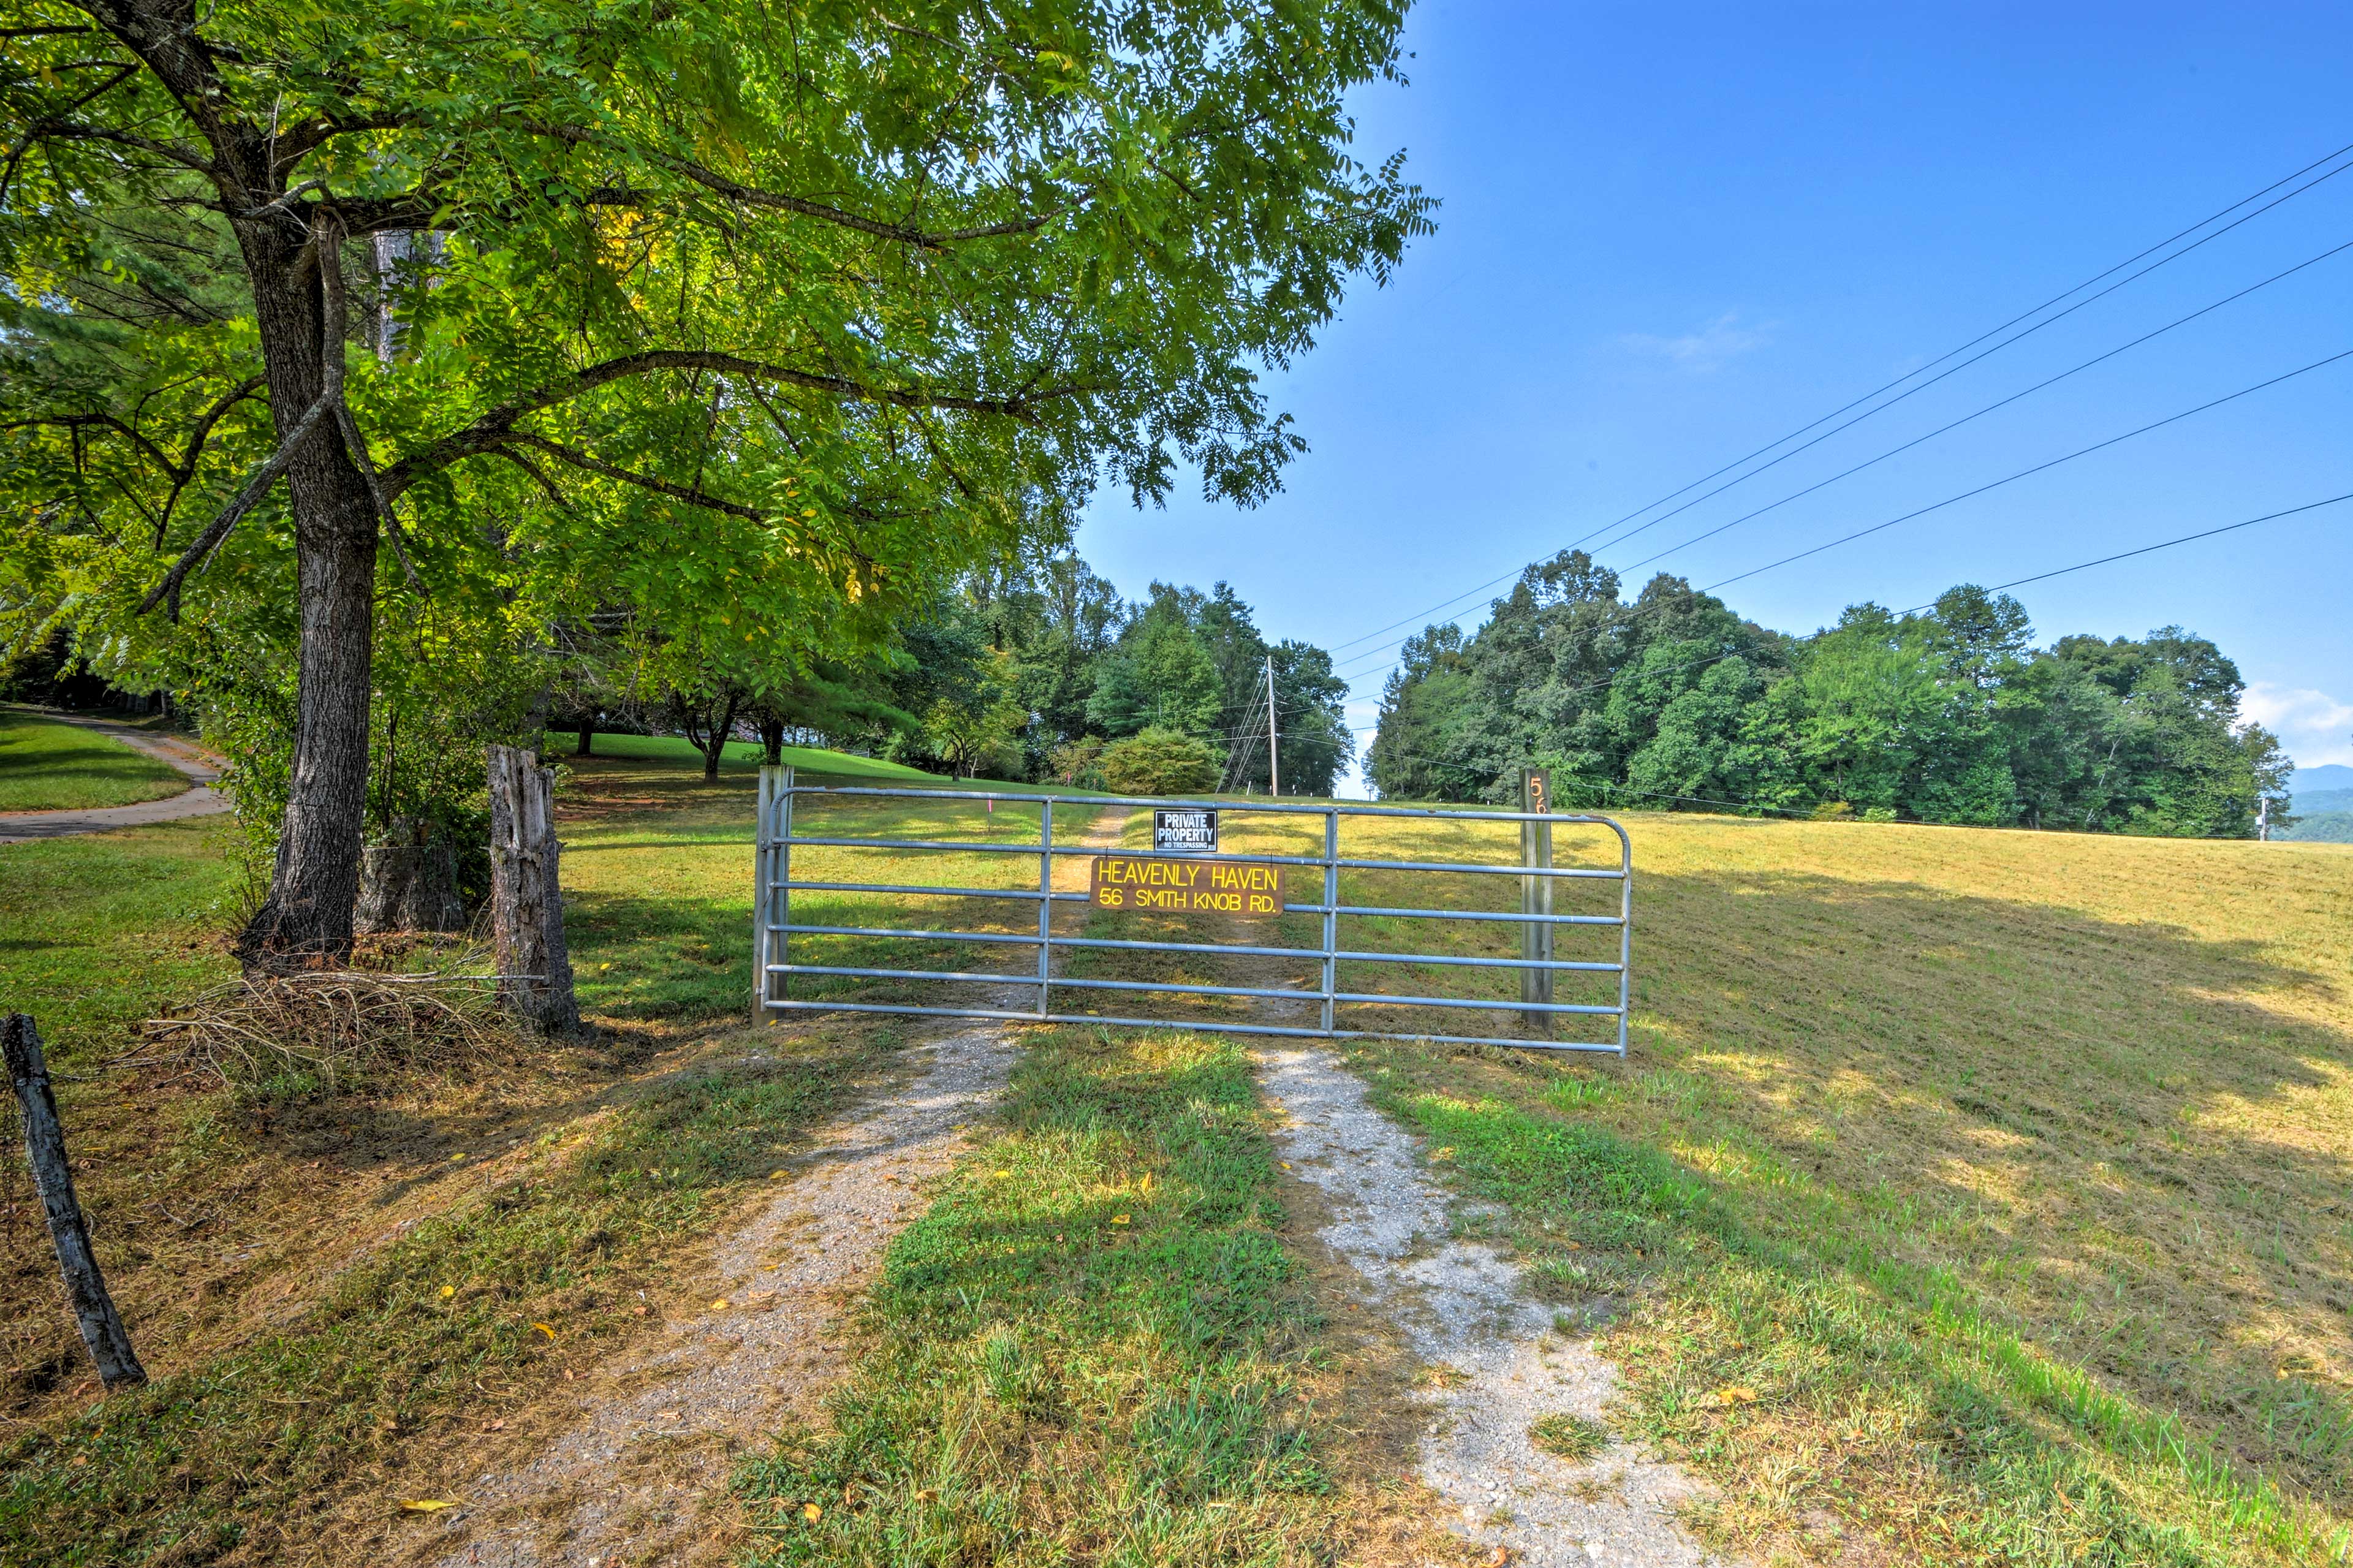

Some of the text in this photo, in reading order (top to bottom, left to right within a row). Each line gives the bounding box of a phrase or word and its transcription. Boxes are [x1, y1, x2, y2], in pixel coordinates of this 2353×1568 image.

[1165, 814, 1207, 828] PRIVATE
[1158, 828, 1213, 841] PROPERTY
[1099, 860, 1278, 891] HEAVENLY HAVEN
[1099, 887, 1276, 913] 56 SMITH KNOB RD.
